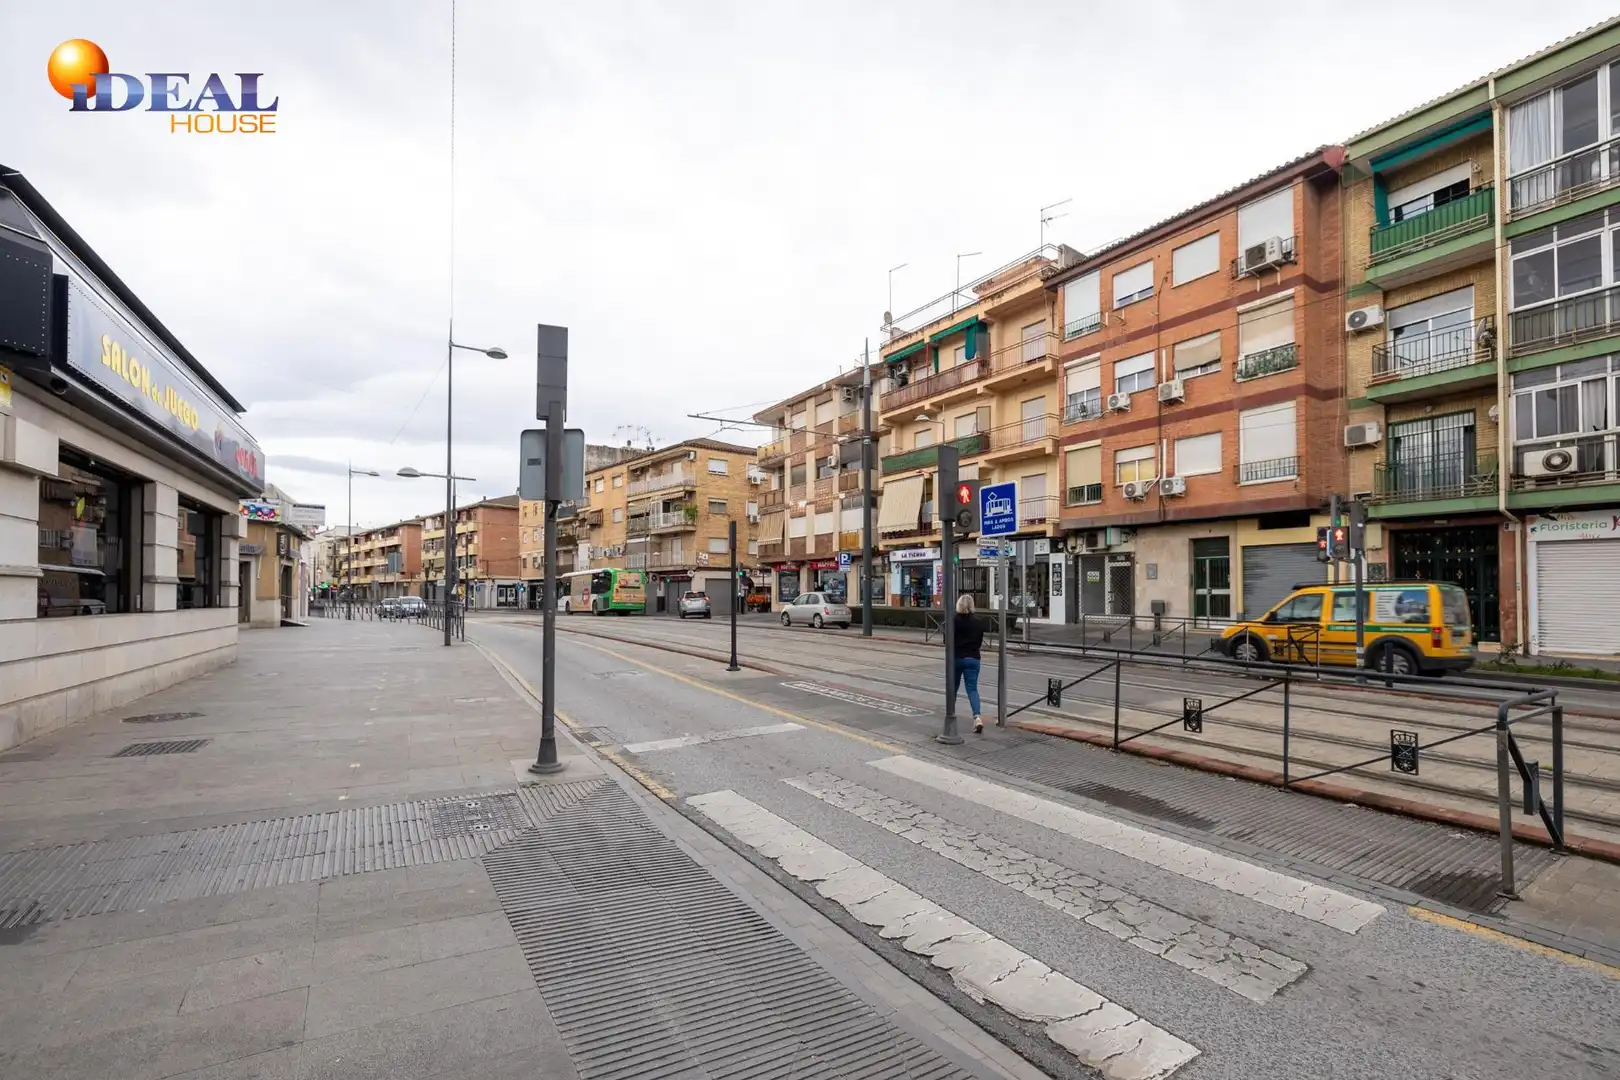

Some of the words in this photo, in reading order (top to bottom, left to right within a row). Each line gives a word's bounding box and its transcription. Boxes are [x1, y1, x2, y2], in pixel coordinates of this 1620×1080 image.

[101, 333, 150, 397] SALON
[1540, 520, 1608, 532] Floristeria
[841, 553, 849, 565] P
